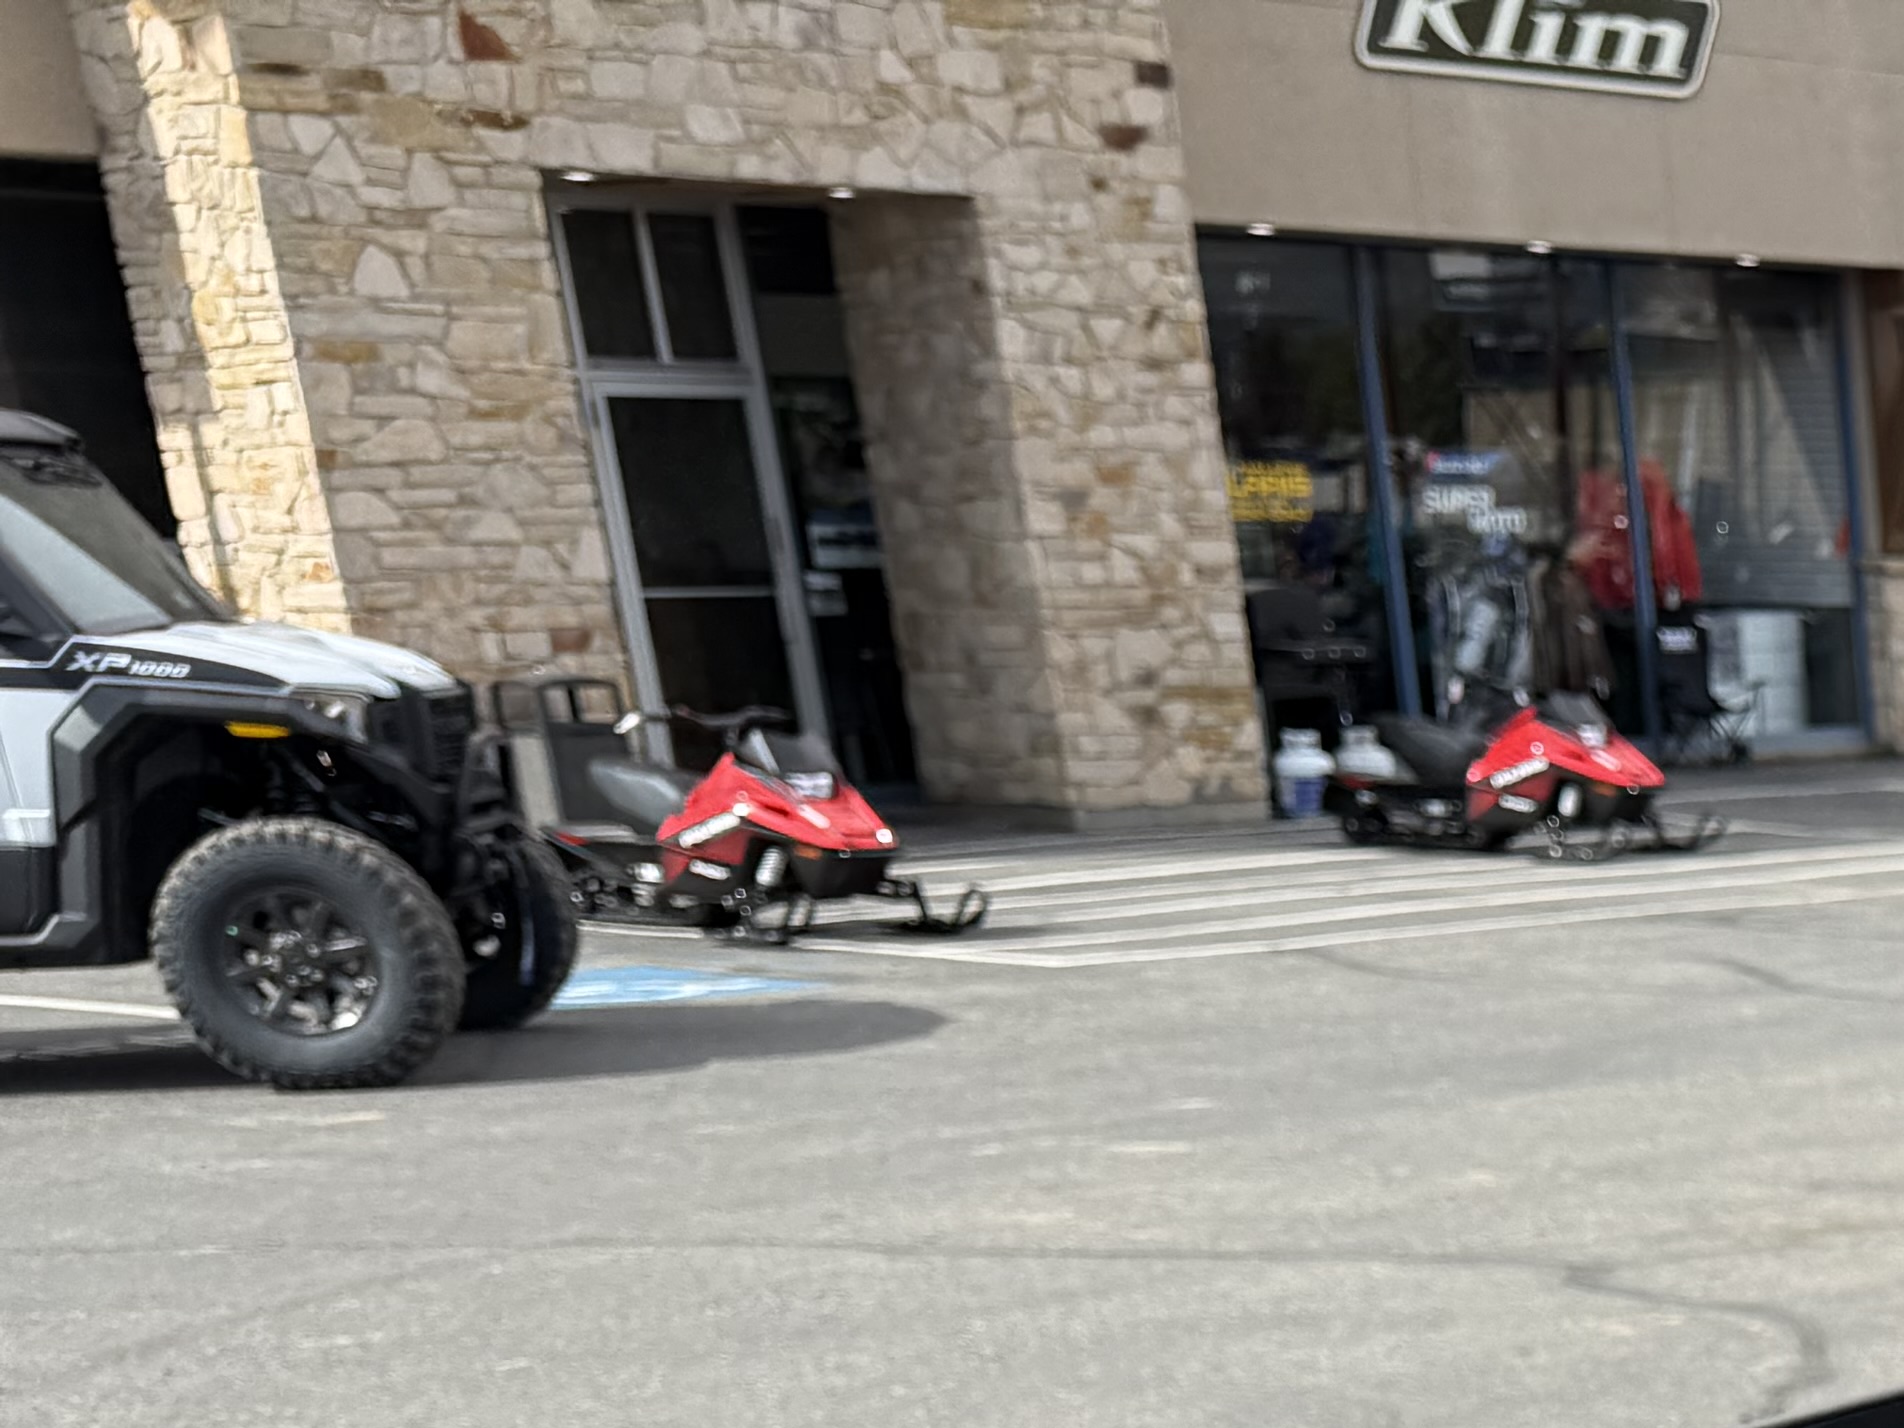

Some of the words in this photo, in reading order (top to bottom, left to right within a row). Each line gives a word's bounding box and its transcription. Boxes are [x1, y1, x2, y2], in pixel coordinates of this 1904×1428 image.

[1379, 0, 1688, 79] Klim
[66, 651, 131, 672] XP
[128, 660, 192, 678] 1000
